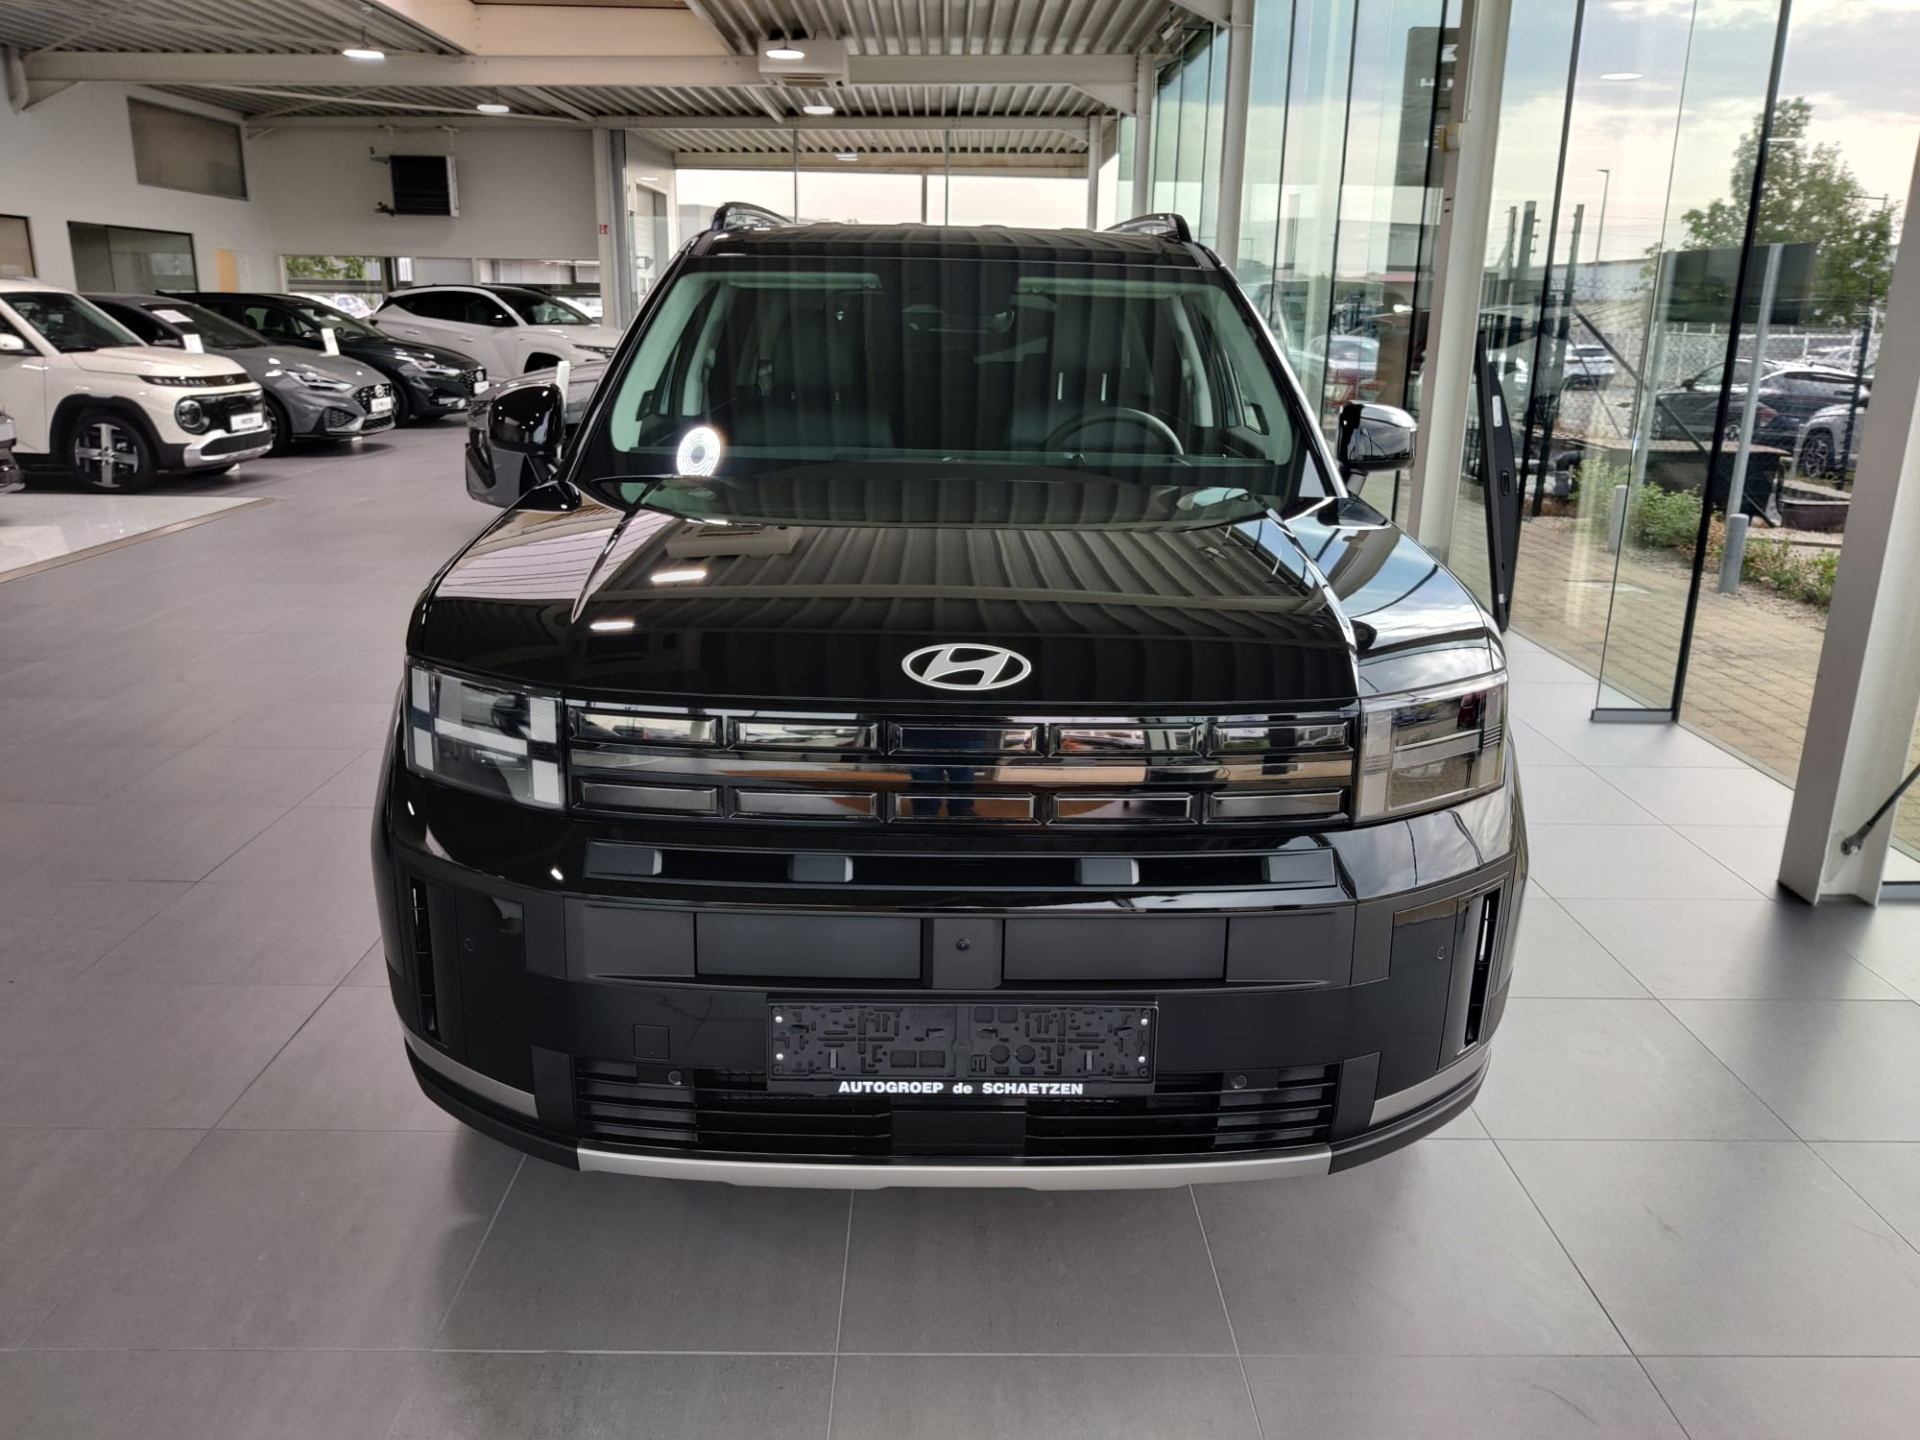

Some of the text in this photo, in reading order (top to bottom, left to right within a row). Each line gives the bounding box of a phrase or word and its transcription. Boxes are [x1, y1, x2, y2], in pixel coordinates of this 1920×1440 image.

[838, 1081, 1084, 1095] AUTOGROEP de SCHAETZEN
